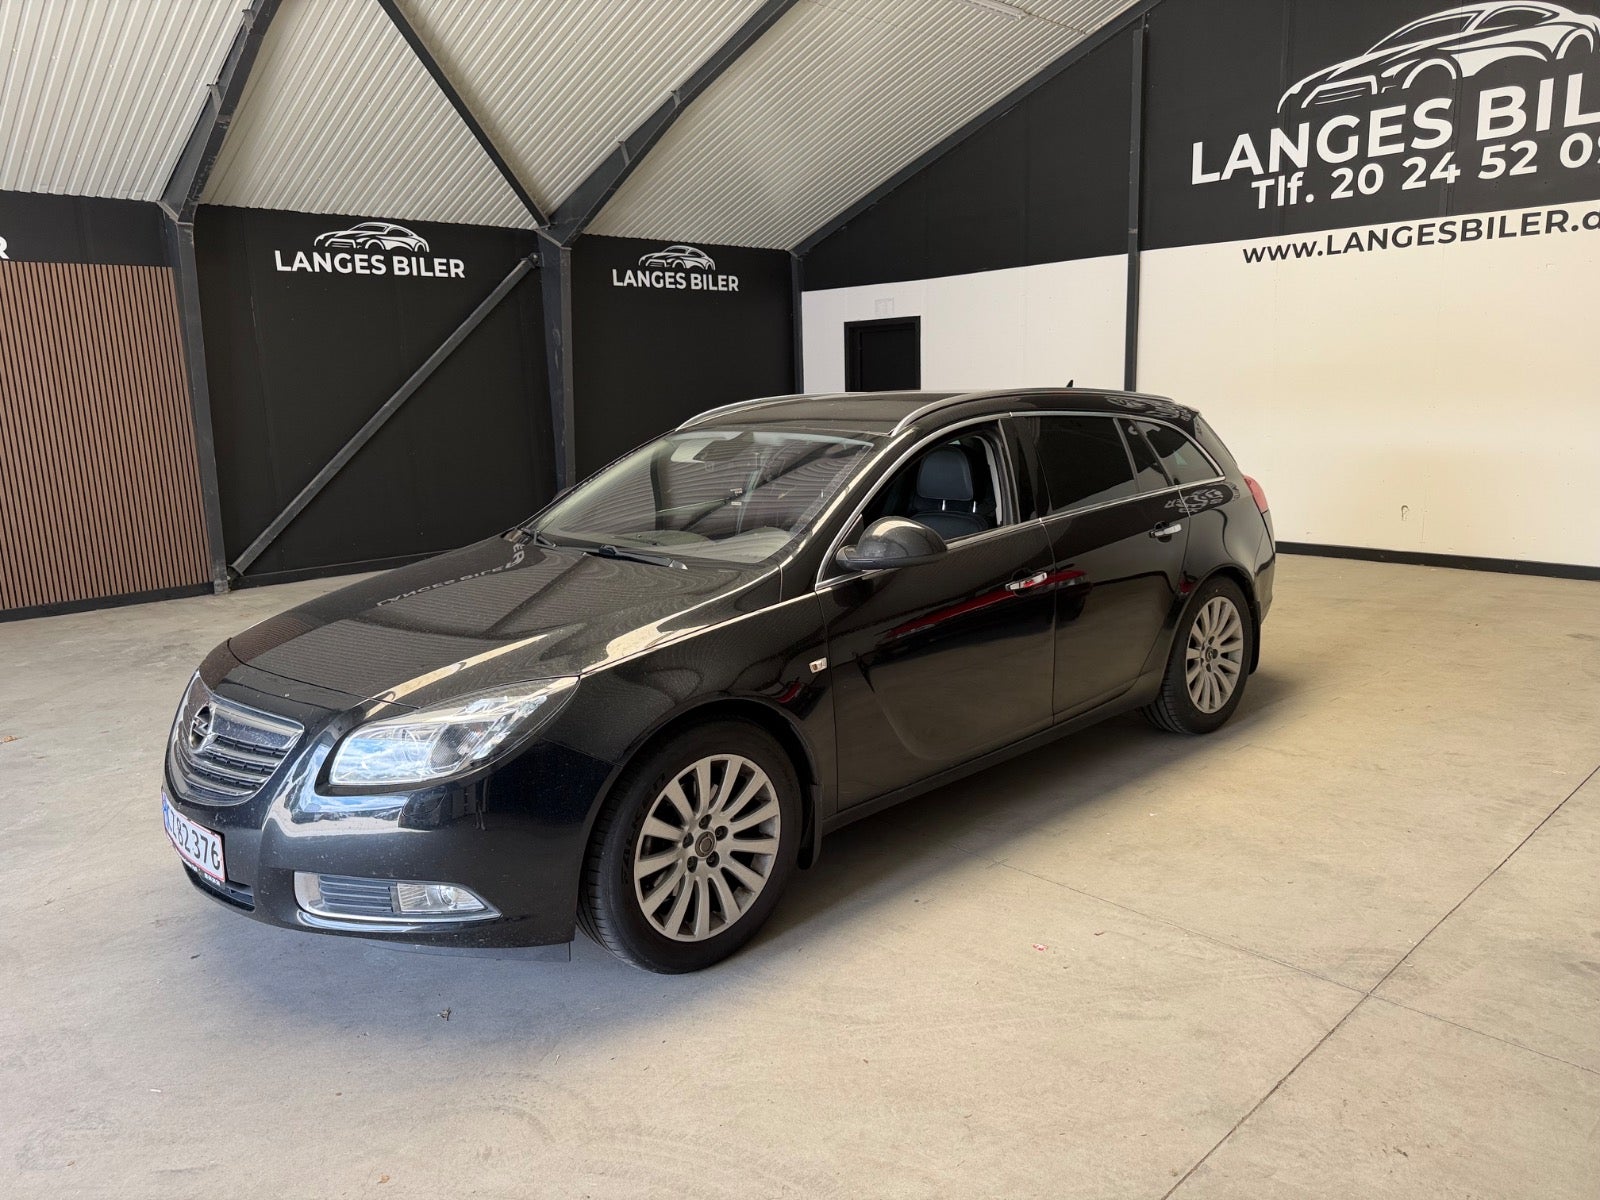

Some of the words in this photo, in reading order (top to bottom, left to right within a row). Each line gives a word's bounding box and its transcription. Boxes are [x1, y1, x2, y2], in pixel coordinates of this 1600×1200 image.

[1191, 97, 1454, 185] LANGES
[1251, 172, 1315, 209] Tlf.
[1330, 163, 1385, 200] 20
[1401, 151, 1462, 191] 24
[1478, 140, 1538, 180] 52
[1559, 132, 1600, 169] 0
[274, 250, 387, 275] LANGES
[392, 255, 466, 279] BILER
[612, 269, 687, 290] LANGES
[690, 273, 739, 292] BILER
